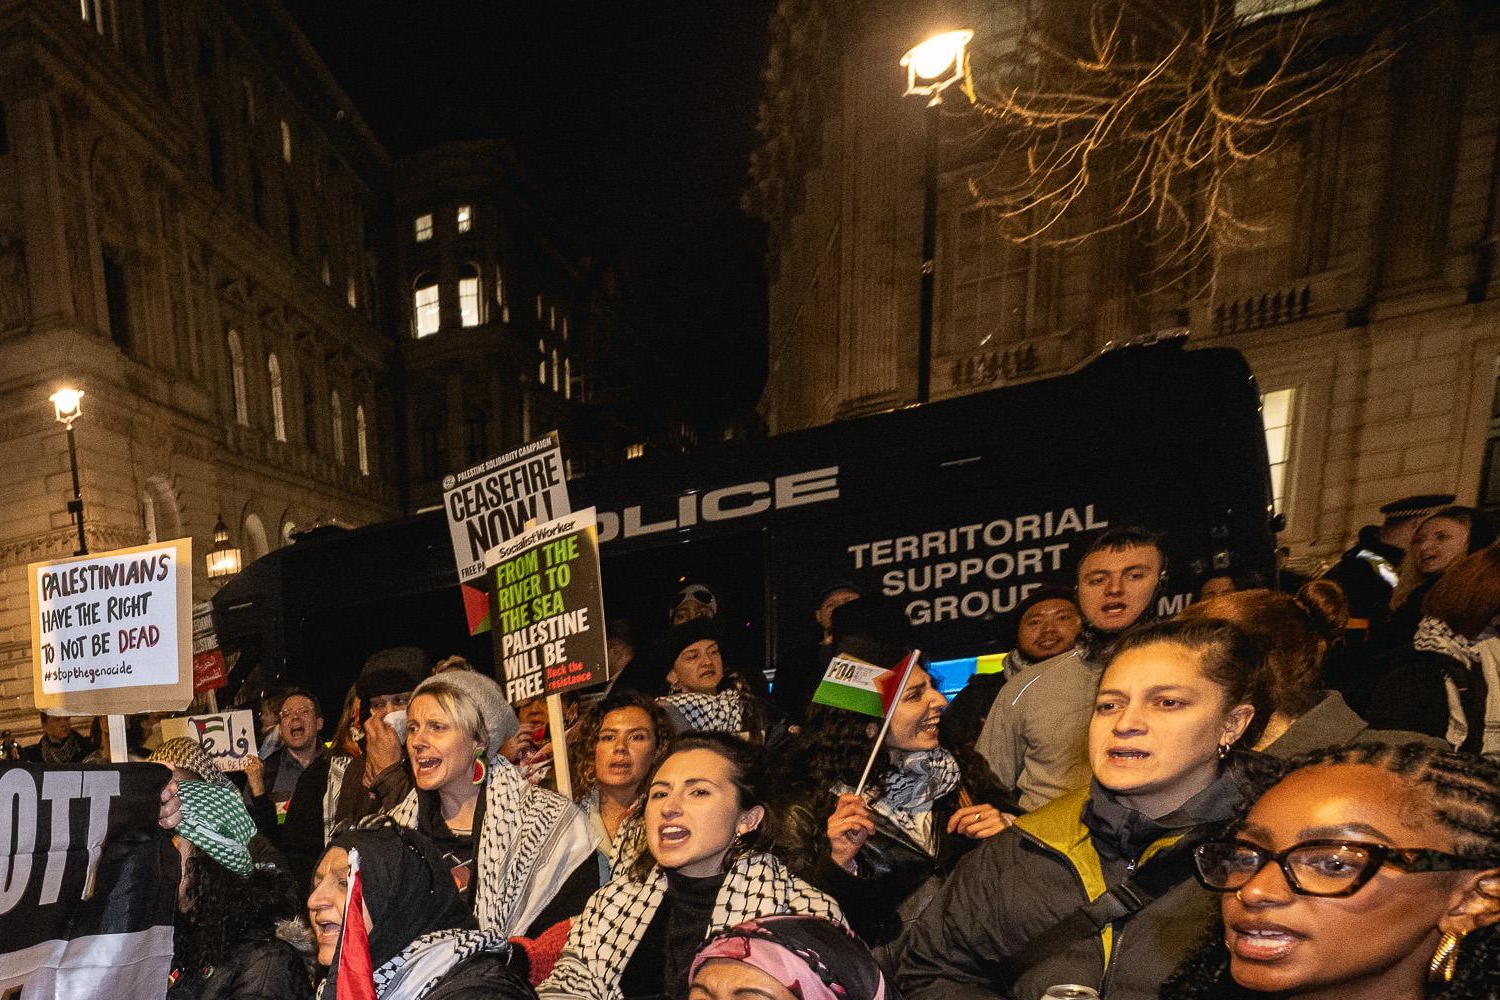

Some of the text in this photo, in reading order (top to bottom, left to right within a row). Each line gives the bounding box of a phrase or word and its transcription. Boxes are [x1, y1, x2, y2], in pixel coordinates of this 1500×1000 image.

[457, 463, 485, 483] PALESTINE
[517, 437, 552, 462] CAMPAIGN
[450, 453, 560, 523] CEASEFIRE
[597, 465, 840, 543] LICE
[535, 519, 576, 543] Worker
[848, 503, 1108, 570] TERRITORIAL
[41, 553, 171, 602] PALESTINIANS
[461, 566, 477, 579] FREE
[496, 534, 580, 588] FROM THE
[882, 542, 1071, 598] SUPPORT
[499, 564, 571, 611] RIVER TO
[41, 591, 152, 633] HAVE THE RIGHT
[501, 591, 565, 634] THE SEA
[502, 607, 590, 658] PALESTINE
[41, 625, 160, 664] TO NOT BE DEAD
[504, 639, 568, 680] WILL BE
[44, 662, 133, 684] #stopthegenocide
[506, 670, 545, 704] FREE
[827, 661, 857, 682] FOA
